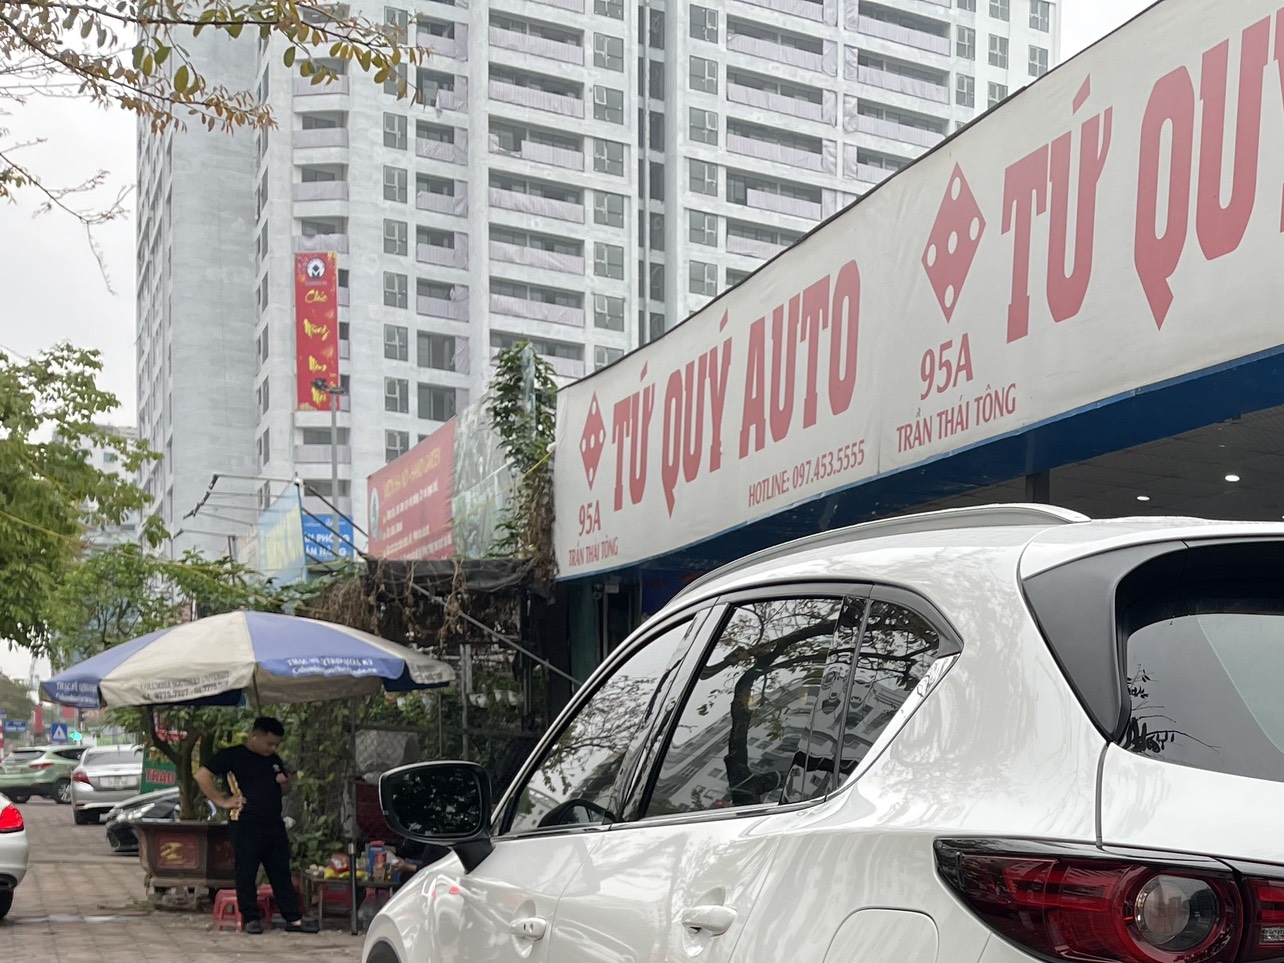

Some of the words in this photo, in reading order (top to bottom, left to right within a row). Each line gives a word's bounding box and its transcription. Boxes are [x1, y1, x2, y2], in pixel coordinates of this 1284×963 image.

[1001, 73, 1113, 344] TỨ
[612, 360, 656, 512] TỨ
[661, 307, 732, 519] QUÝ
[738, 259, 861, 460] AUTO
[920, 333, 974, 401] 95A
[937, 394, 970, 440] THÁI
[974, 383, 1017, 426] TÔNG
[748, 469, 790, 508] HOTLINE:
[792, 439, 865, 489] 097.453.5555
[579, 499, 601, 537] 95A
